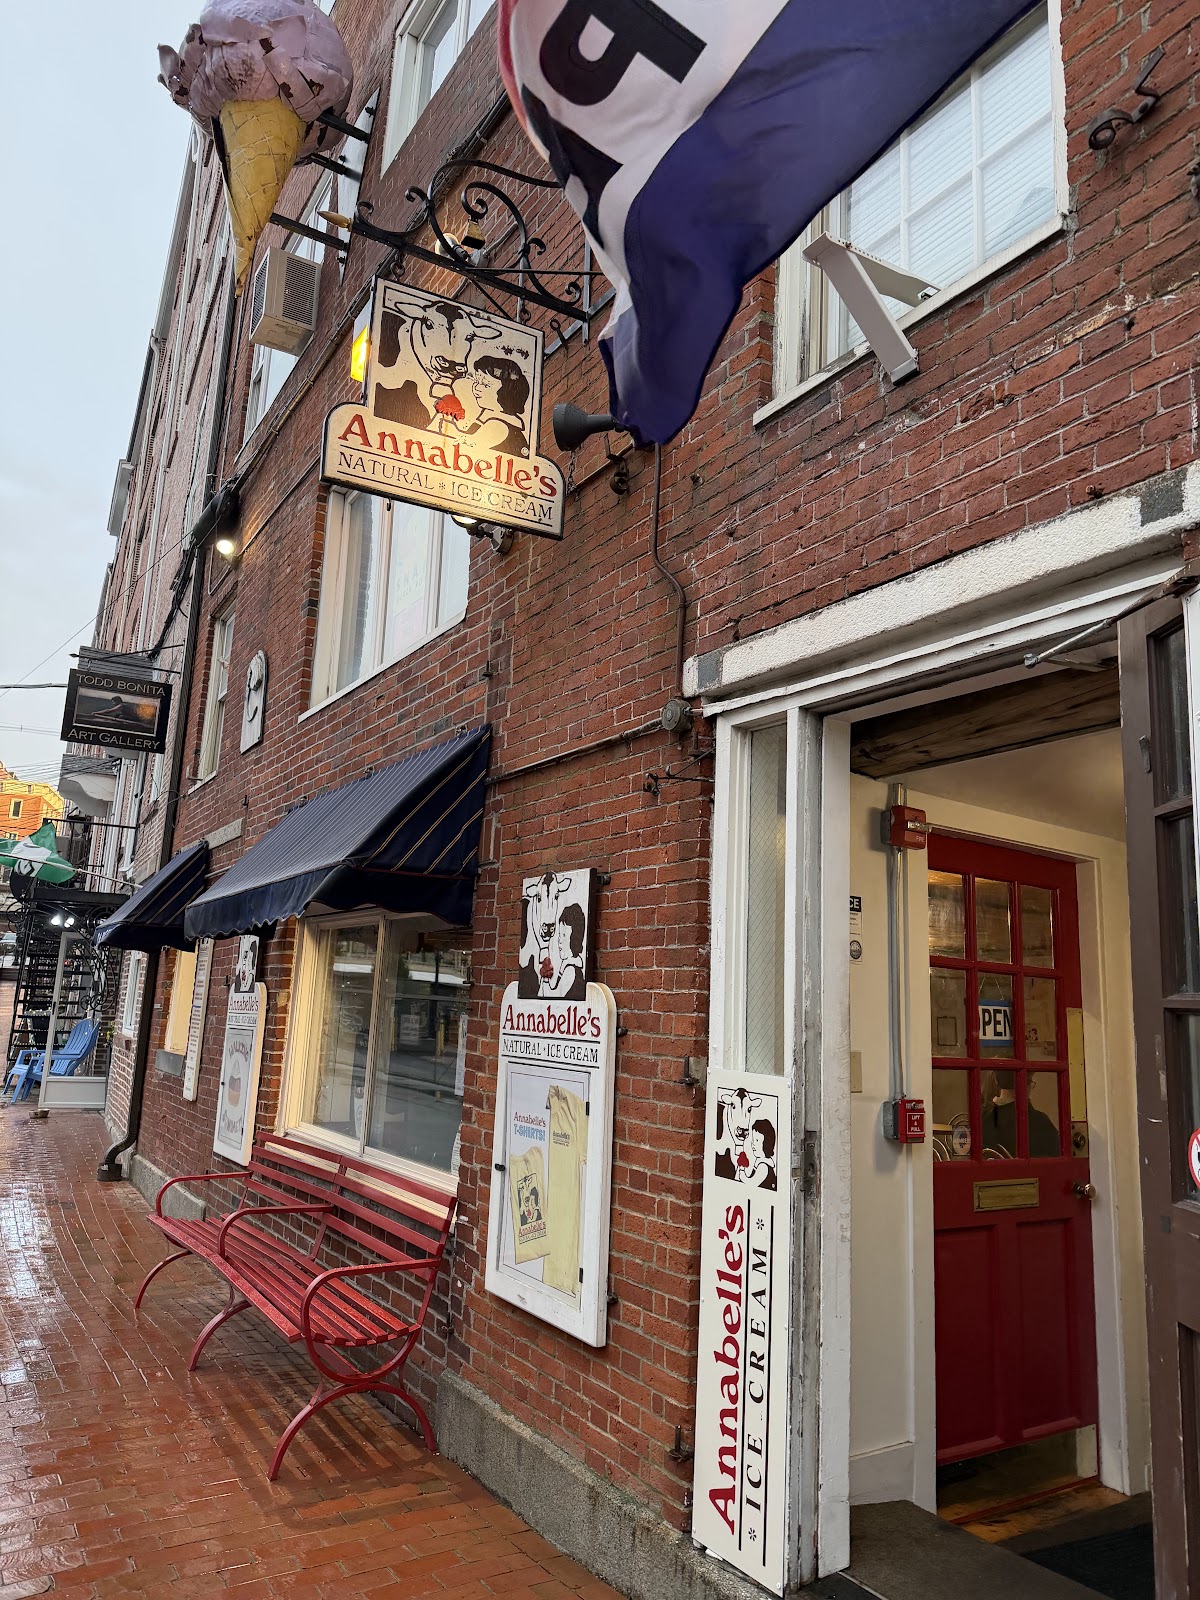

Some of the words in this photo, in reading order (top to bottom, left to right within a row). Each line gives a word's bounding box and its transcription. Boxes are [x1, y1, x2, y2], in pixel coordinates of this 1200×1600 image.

[338, 413, 557, 497] Annabelle's
[338, 451, 434, 490] NATURAL
[451, 481, 482, 502] ICE
[488, 492, 553, 520] CREAM
[76, 673, 114, 688] TODD
[117, 680, 166, 697] BONITA
[67, 728, 96, 741] ART
[98, 732, 160, 750] GALLERY
[850, 898, 860, 909] CE
[502, 1004, 601, 1038] Annabelle's
[979, 1008, 1012, 1037] PEN
[502, 1038, 542, 1056] NATURAL
[546, 1043, 562, 1059] ICE
[563, 1045, 598, 1063] CREAM
[513, 1111, 547, 1128] Annabelle's
[748, 1246, 768, 1404] CREAM
[709, 1205, 745, 1536] Annabelle's
[746, 1433, 763, 1513] ICE
